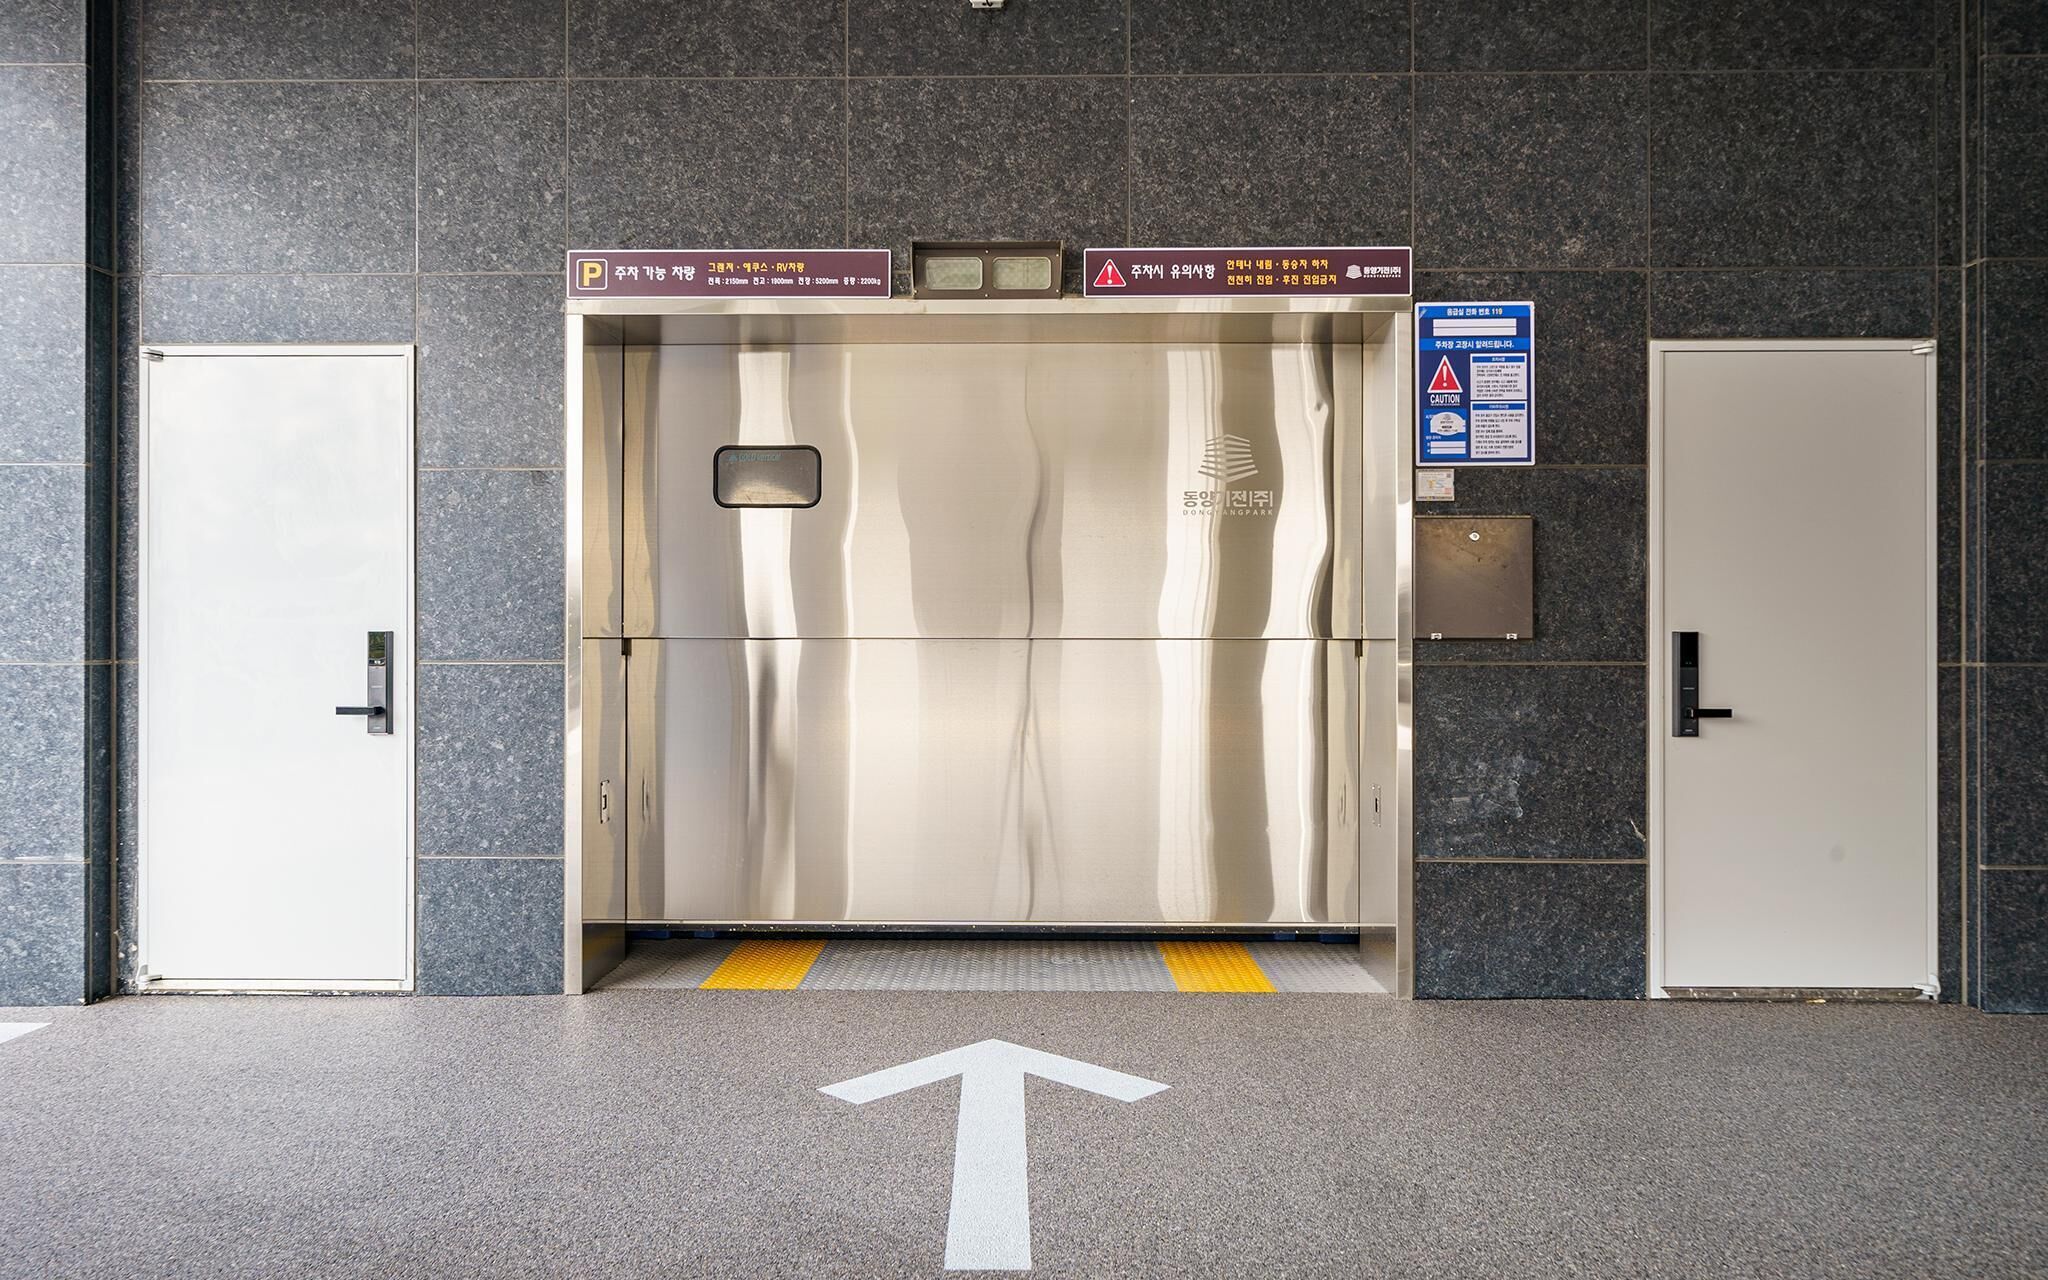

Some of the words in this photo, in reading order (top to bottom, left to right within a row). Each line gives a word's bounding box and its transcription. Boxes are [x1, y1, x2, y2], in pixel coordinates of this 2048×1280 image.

[776, 262, 805, 273] RV차량
[1226, 259, 1252, 270] 안테나
[1255, 259, 1273, 270] 내림
[1282, 259, 1308, 270] 동승자
[1311, 259, 1329, 270] 하차
[583, 262, 602, 287] P
[614, 266, 640, 281] 주차
[642, 266, 667, 281] 가능
[671, 266, 696, 281] 차량
[1131, 264, 1164, 280] 주차시
[1170, 264, 1216, 280] 유의사항
[1227, 274, 1252, 286] 천천히
[1256, 274, 1273, 286] 진입
[1282, 274, 1299, 286] 후진
[1303, 274, 1337, 286] 진입금지
[1465, 308, 1477, 316] 전화
[1478, 308, 1490, 316] 번호
[1492, 308, 1503, 316] 119
[1435, 340, 1454, 349] 주차장
[1455, 340, 1474, 349] 고장시
[1430, 394, 1460, 404] CAUTION
